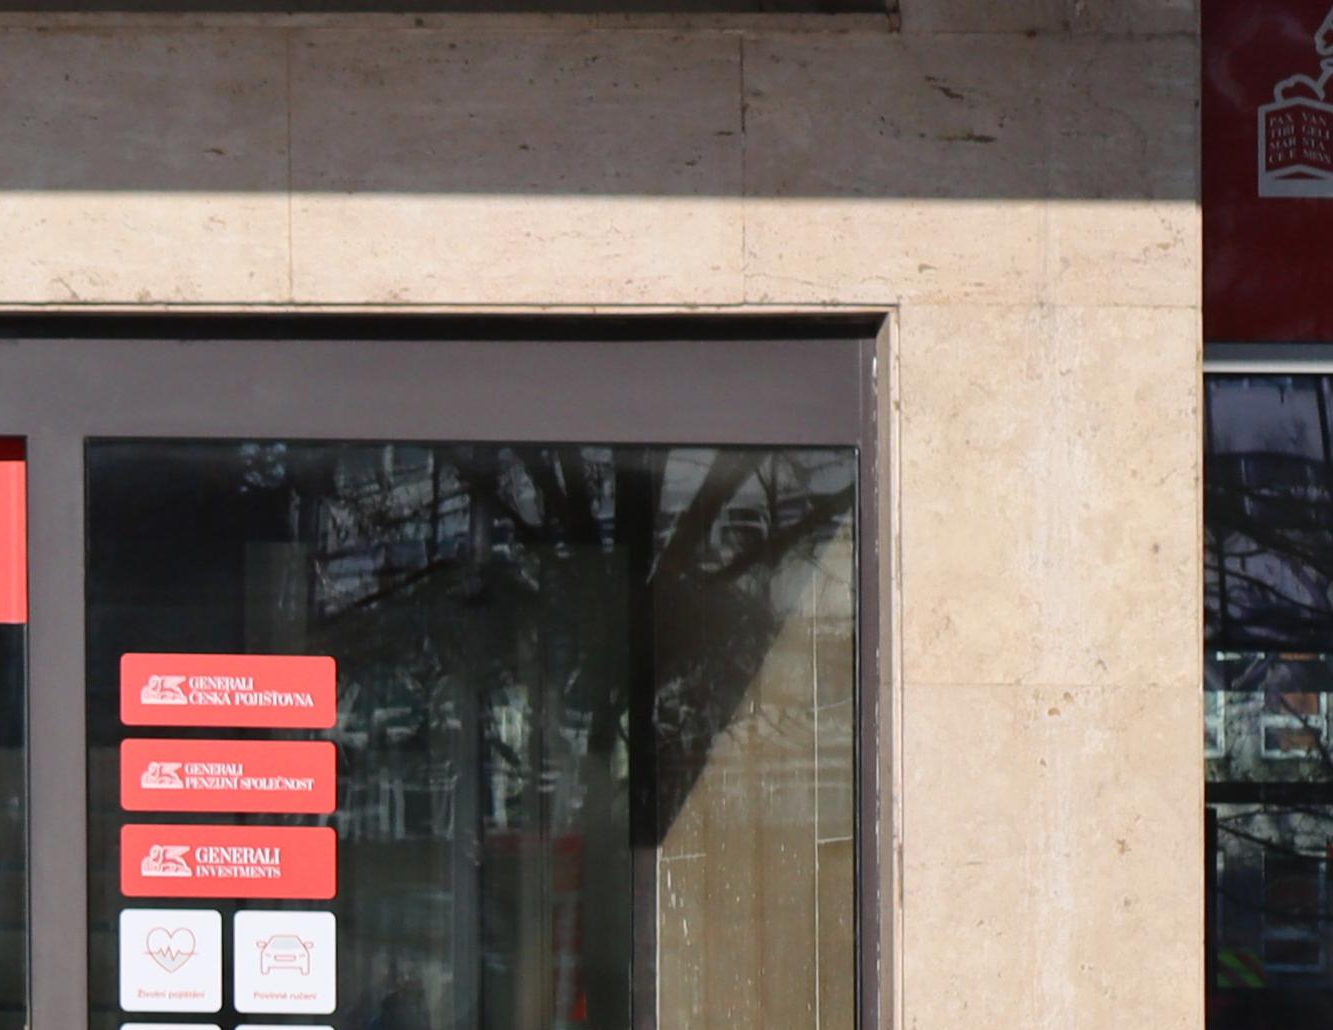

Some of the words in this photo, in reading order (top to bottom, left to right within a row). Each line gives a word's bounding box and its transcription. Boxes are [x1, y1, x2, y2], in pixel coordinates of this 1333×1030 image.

[189, 676, 253, 691] GENERALI
[189, 690, 231, 705] ČESKÁ
[234, 691, 314, 707] POJIŠŤOVNA
[185, 763, 243, 776] GENERALI
[185, 776, 239, 790] PENZIJNÍ
[240, 777, 314, 791] SPOLEČNOST
[195, 847, 281, 865] GENERALI
[196, 866, 281, 878] INVESTMENTS
